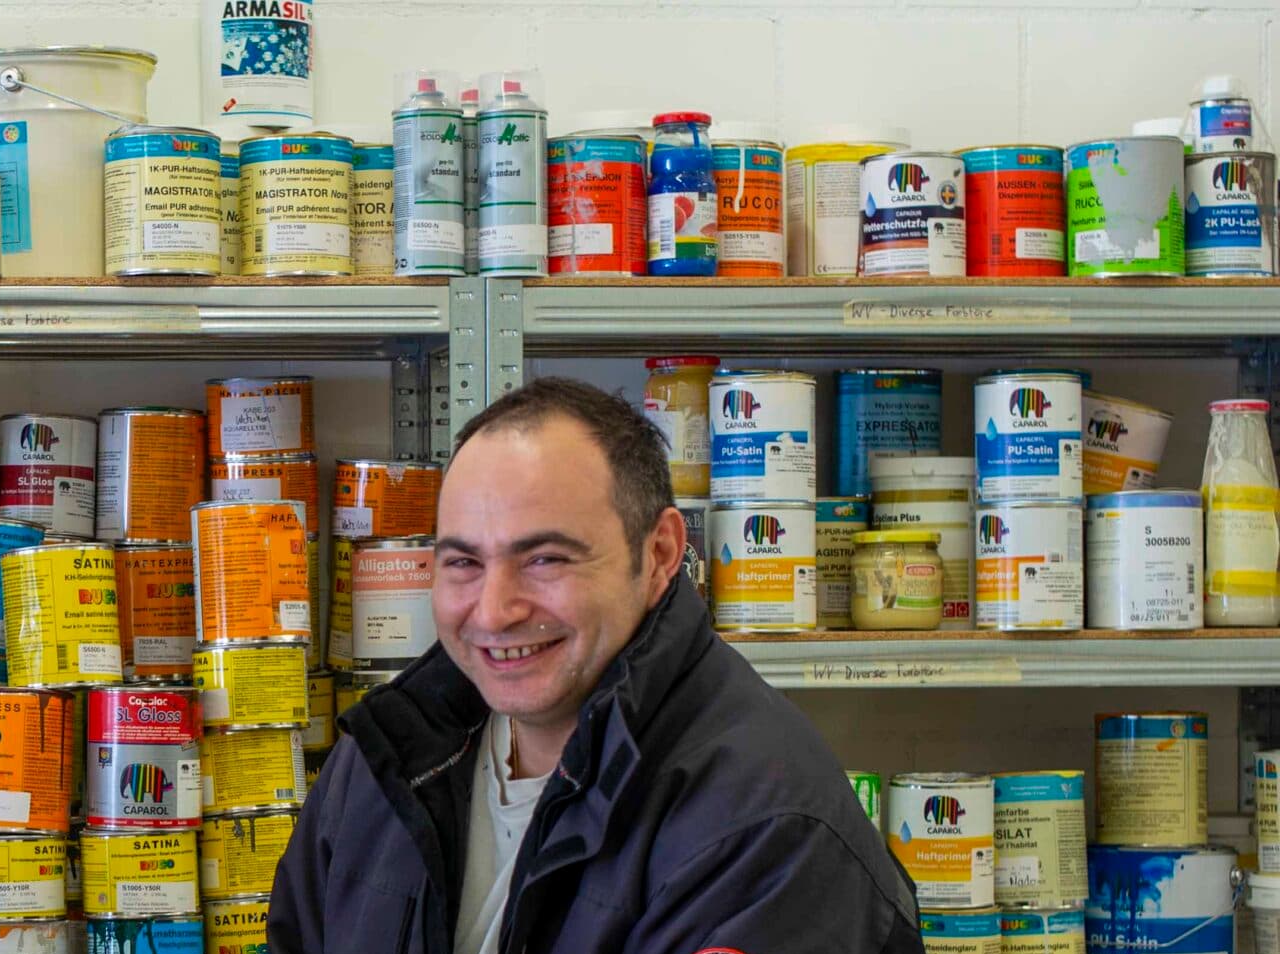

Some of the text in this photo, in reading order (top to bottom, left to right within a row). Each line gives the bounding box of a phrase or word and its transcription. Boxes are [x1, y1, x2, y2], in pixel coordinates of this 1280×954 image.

[223, 1, 305, 21] ARMASIL
[488, 169, 520, 177] standard
[144, 187, 214, 197] MAGISTRATOR
[256, 189, 348, 199] MAGISTRATOR Nova
[256, 206, 275, 214] Email
[1205, 218, 1260, 228] 2K PU-Lack
[726, 421, 757, 429] CAPAROL
[722, 447, 762, 456] PU-Satin
[1008, 446, 1053, 455] PU-Satin
[900, 513, 920, 521] Plus
[1145, 526, 1152, 534] S
[359, 558, 416, 573] Alligator
[737, 572, 792, 581] Haftprimer
[116, 709, 181, 723] SL Gloss
[124, 806, 168, 815] CAPAROL
[134, 839, 180, 849] SATINA
[917, 851, 971, 861] Haftprimer
[140, 859, 175, 870] RUCO
